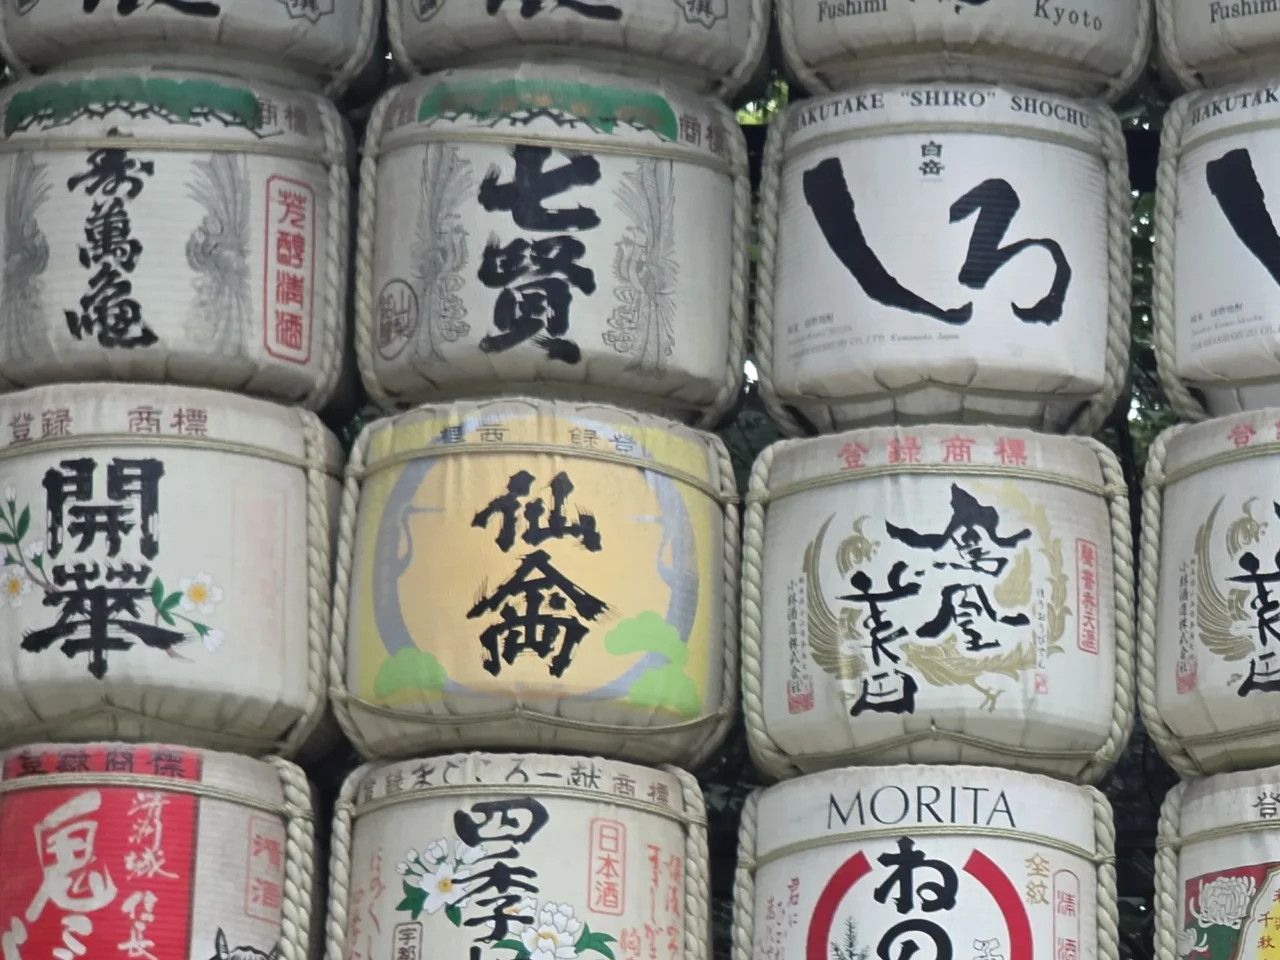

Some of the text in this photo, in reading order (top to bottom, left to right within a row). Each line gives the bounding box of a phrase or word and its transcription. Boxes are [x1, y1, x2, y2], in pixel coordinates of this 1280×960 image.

[1033, 0, 1103, 31] Kyoto
[477, 145, 602, 365] 七賢
[803, 157, 1072, 326] しろ
[21, 457, 188, 681] 開華
[593, 826, 622, 911] 日本酒
[827, 785, 1016, 830] MORITA
